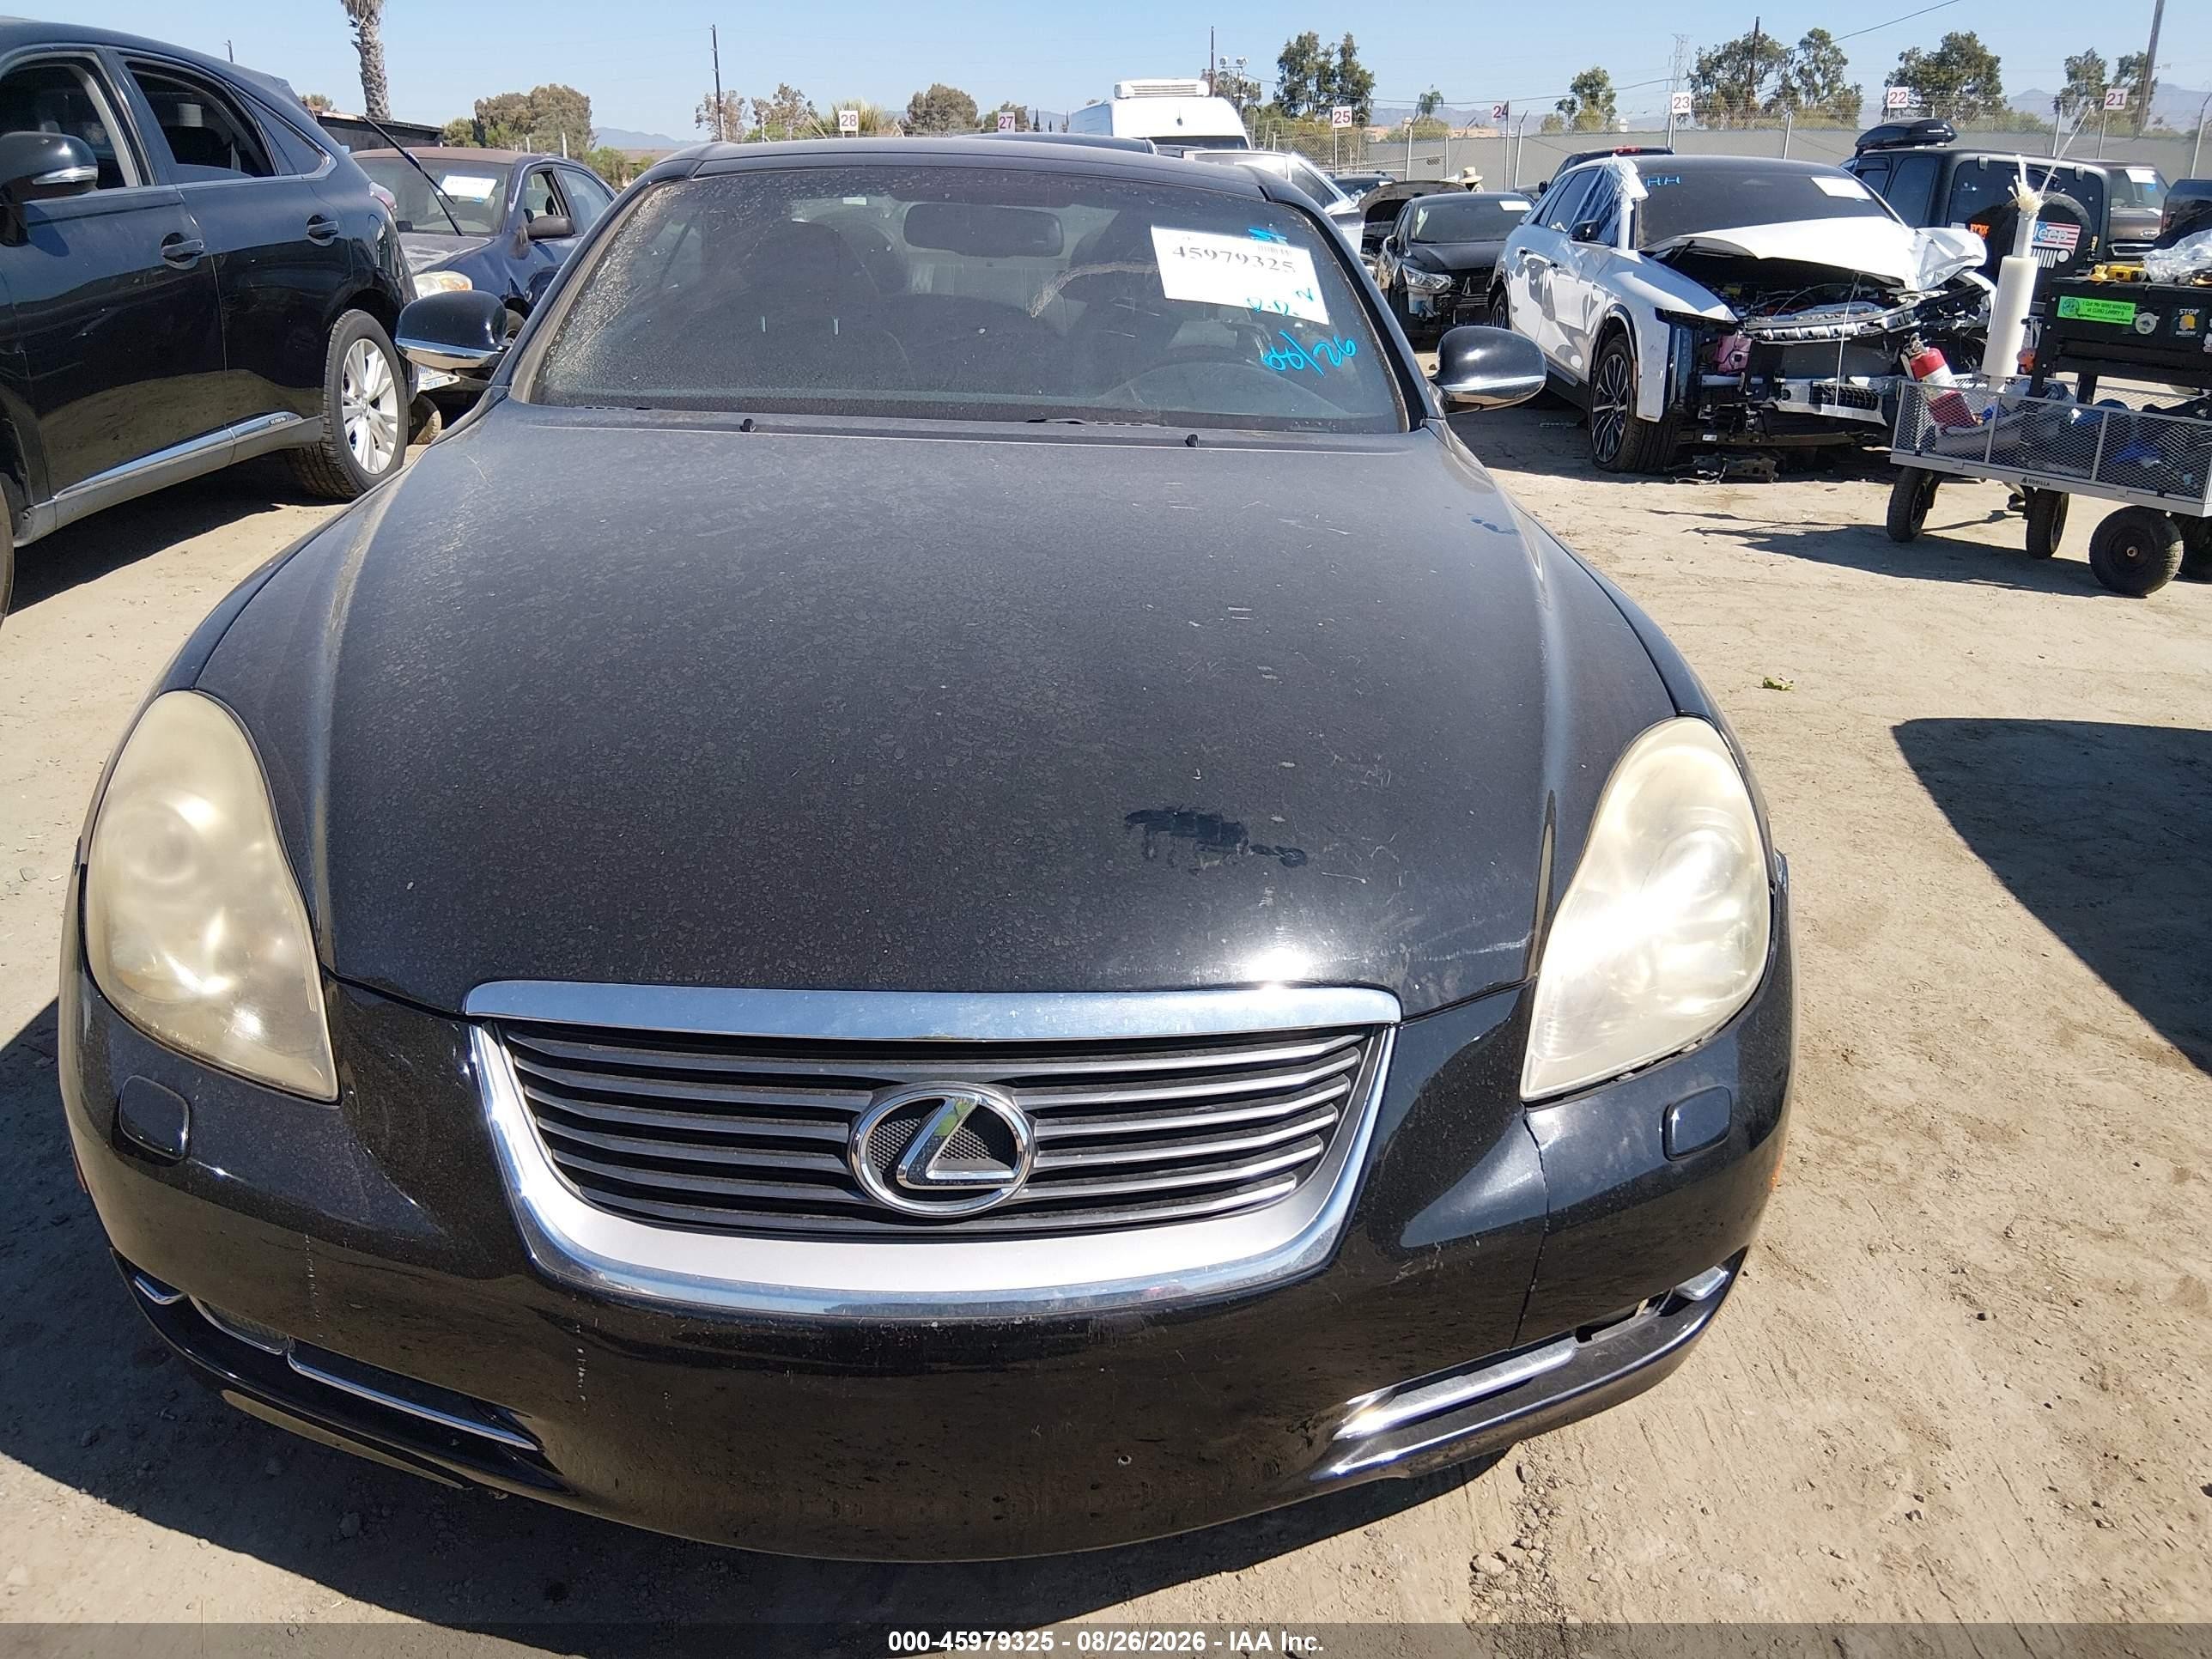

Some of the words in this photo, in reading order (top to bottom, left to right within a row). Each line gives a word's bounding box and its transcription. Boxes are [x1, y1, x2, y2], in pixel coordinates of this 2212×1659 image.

[1674, 96, 1690, 109] 23
[1889, 91, 1907, 104] 22
[2106, 93, 2125, 106] 21
[1334, 111, 1351, 125] 25
[1492, 105, 1509, 118] 24
[841, 114, 858, 127] 28
[999, 116, 1014, 129] 27
[1172, 246, 1296, 274] 45979325
